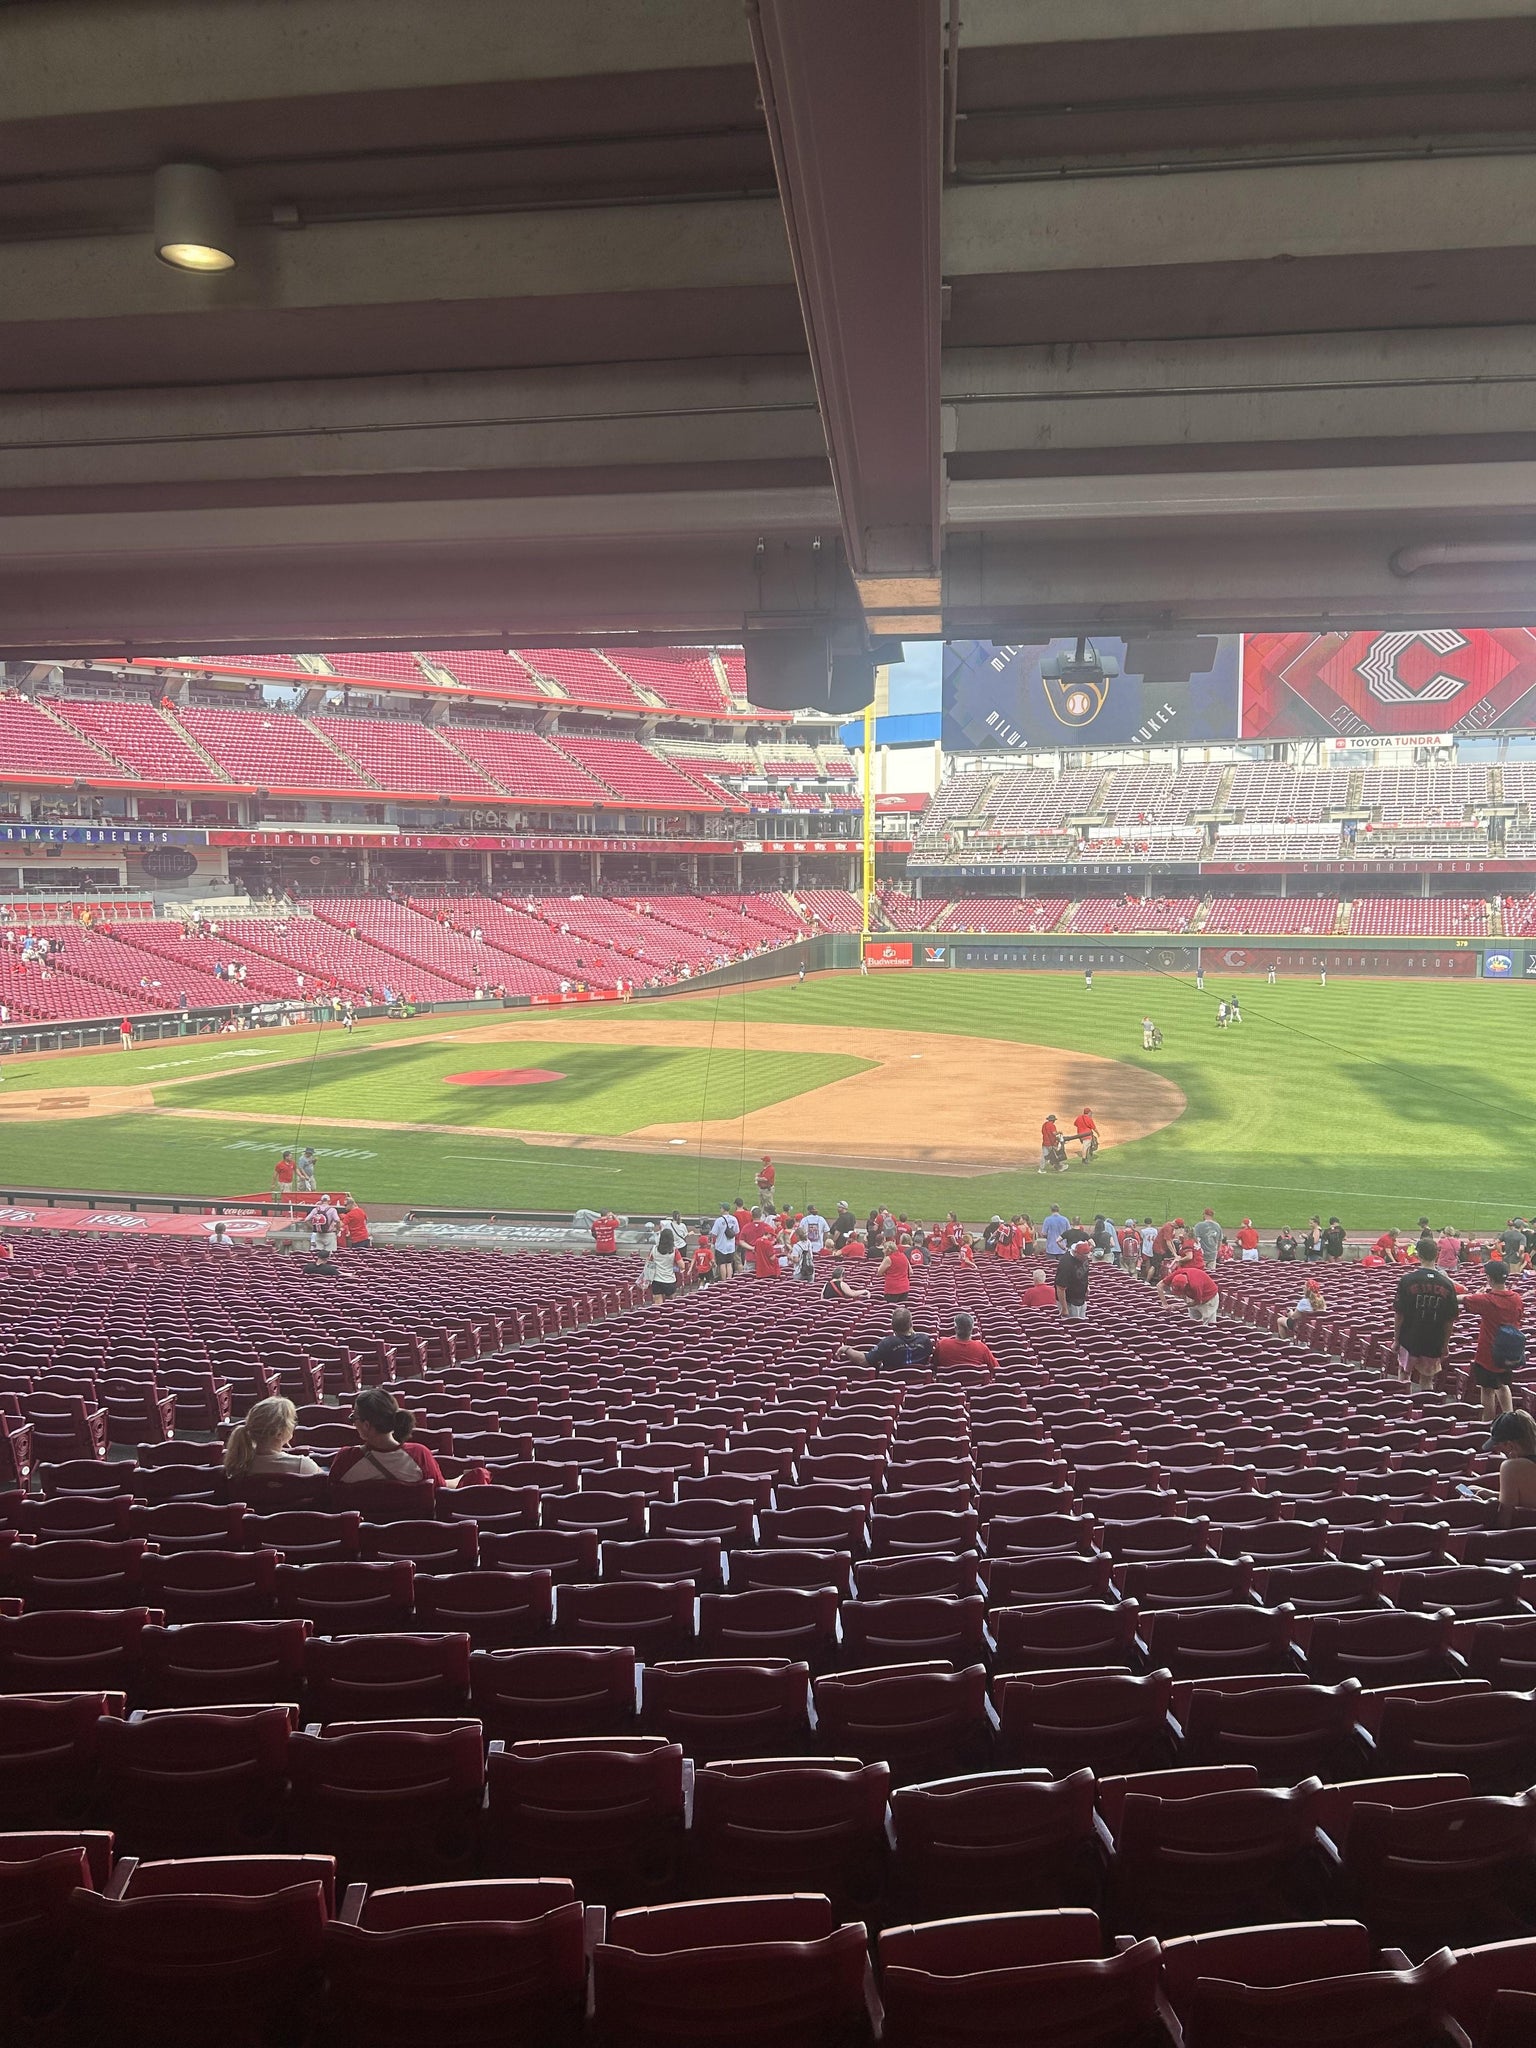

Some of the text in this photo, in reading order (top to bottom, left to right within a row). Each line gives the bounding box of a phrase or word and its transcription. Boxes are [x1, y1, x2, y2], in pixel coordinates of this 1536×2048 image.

[990, 644, 1024, 673] MIL
[1350, 736, 1442, 748] TOYOTA TUNDRA
[86, 828, 168, 842] BREWERS
[251, 833, 423, 848] CINCINNATI REDS
[501, 839, 637, 850] CINCINNATI REDS
[961, 866, 1133, 875] MILWAUKEE BREWERS
[1303, 862, 1485, 873] CINCINNATI REDS
[866, 957, 911, 967] Budweiser
[966, 953, 1125, 963] MILWAUKEE BREWERS
[1276, 956, 1455, 968] CINCINNATI REDS
[88, 1214, 144, 1227] 1990
